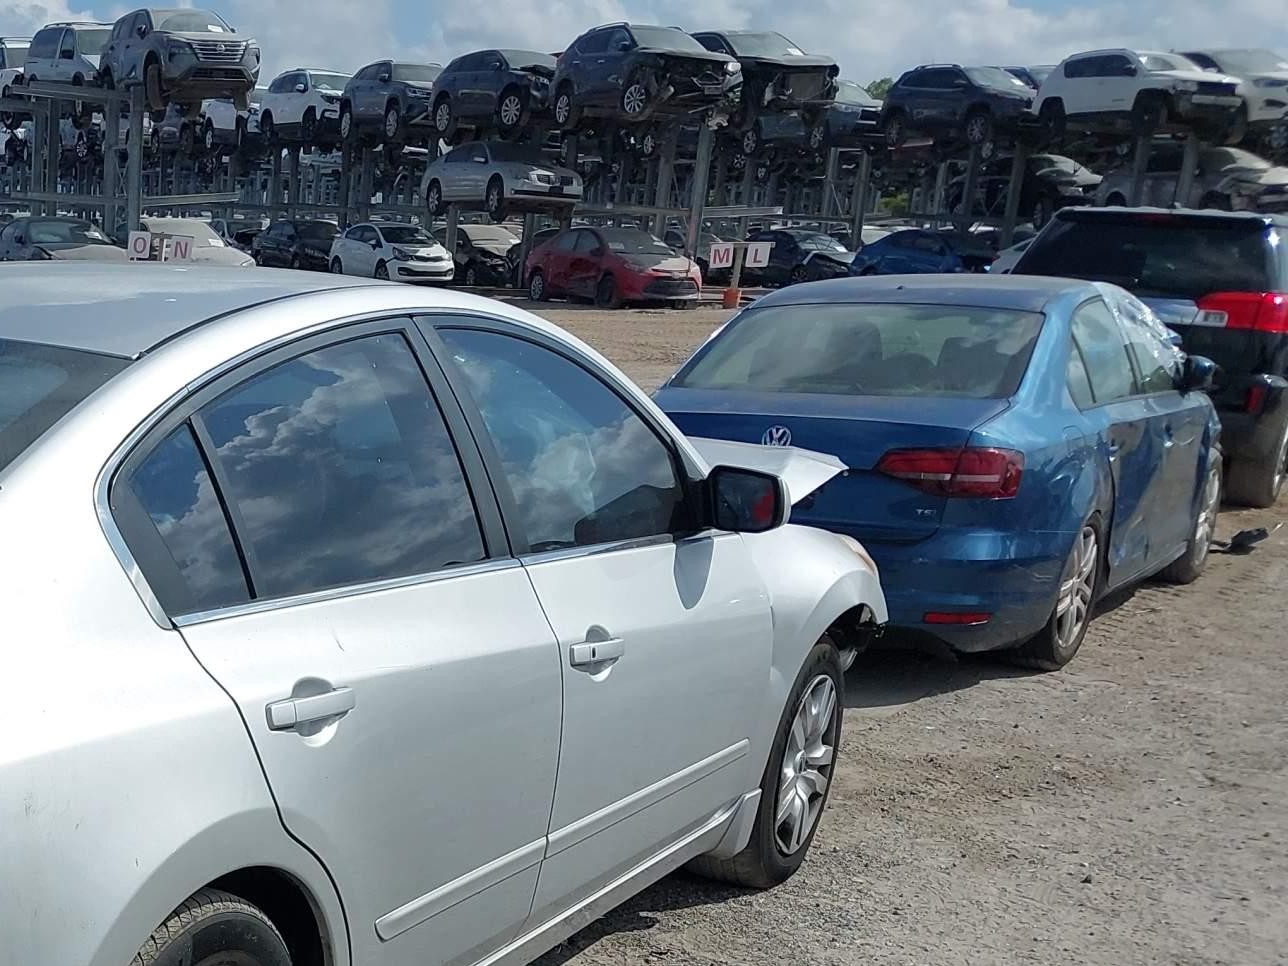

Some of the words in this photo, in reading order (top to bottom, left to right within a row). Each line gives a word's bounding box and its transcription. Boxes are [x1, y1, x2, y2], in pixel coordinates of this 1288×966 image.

[133, 236, 147, 254] O
[174, 240, 189, 259] N
[712, 247, 730, 265] M
[752, 247, 763, 264] L
